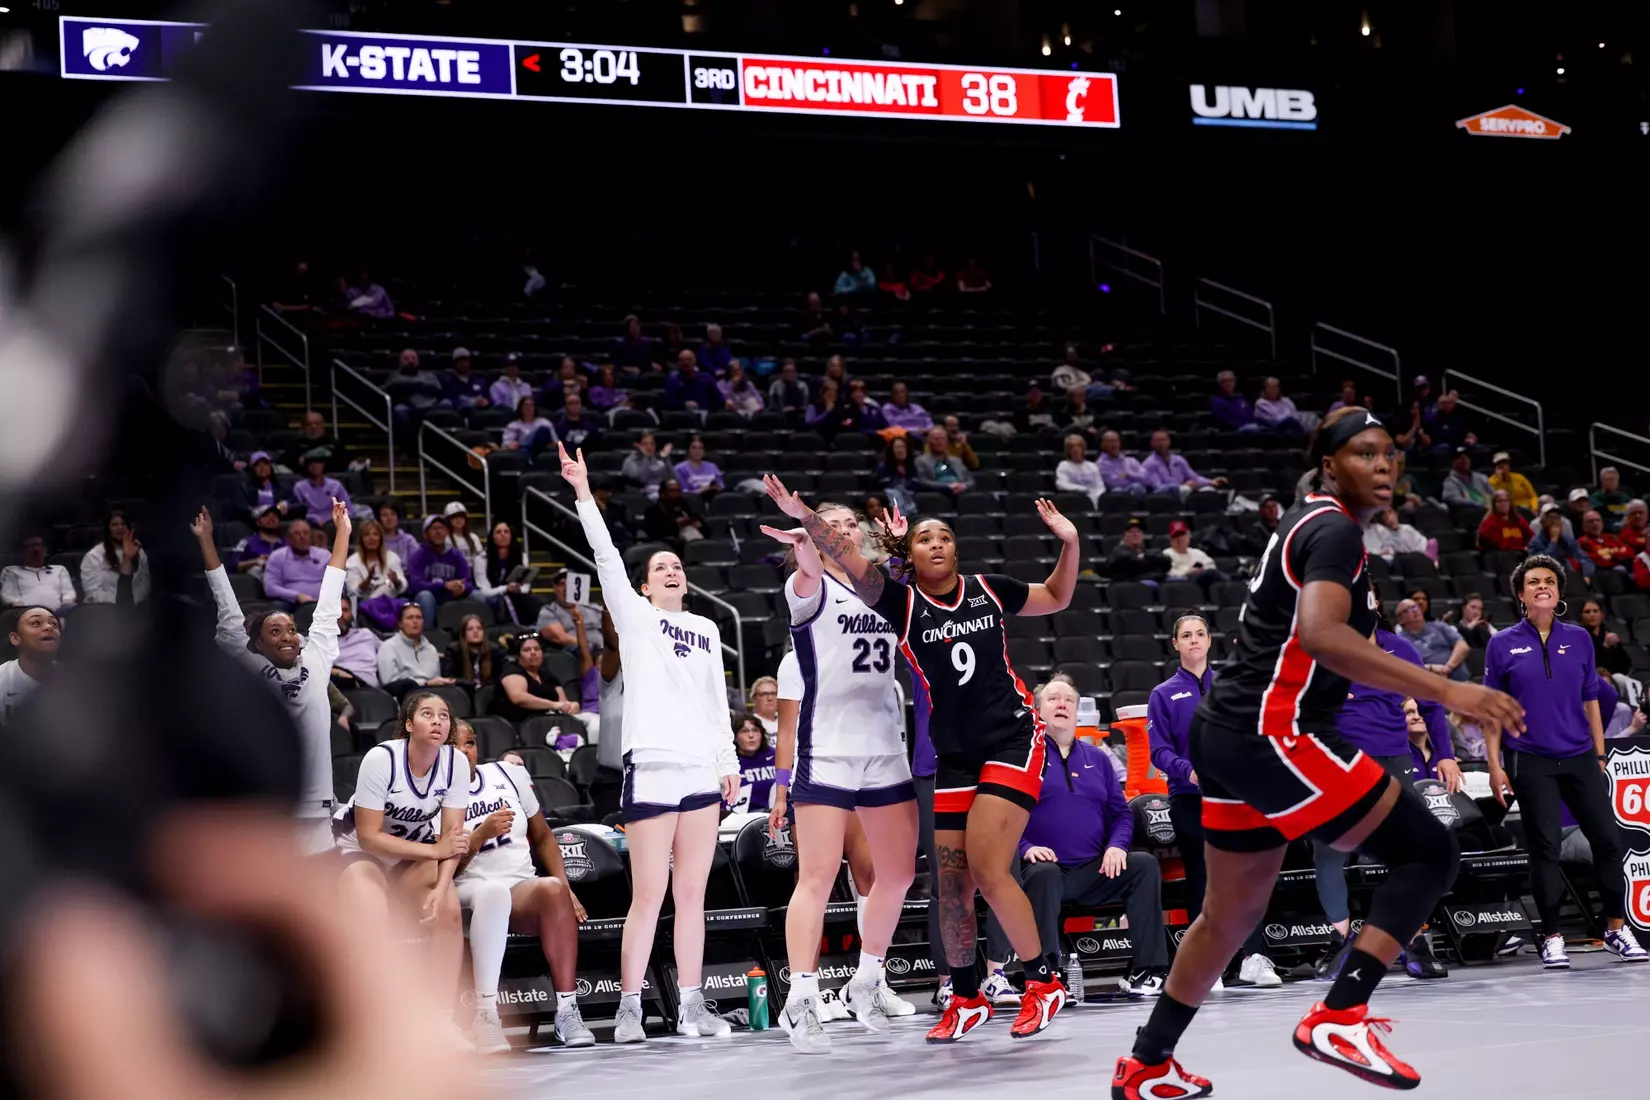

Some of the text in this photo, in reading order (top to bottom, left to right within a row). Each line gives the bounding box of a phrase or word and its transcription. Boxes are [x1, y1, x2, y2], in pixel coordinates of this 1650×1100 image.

[322, 43, 481, 84] K-STATE
[560, 48, 640, 85] 3:04
[694, 68, 735, 89] 3RD
[744, 66, 938, 107] CINCINNATI
[961, 73, 1017, 116] 38
[1190, 84, 1317, 121] UMB
[1480, 117, 1547, 134] SERVPRO
[574, 576, 582, 601] 3
[837, 613, 896, 634] Wildca
[922, 614, 995, 643] CINCINNATI
[852, 637, 891, 674] 23
[951, 641, 976, 687] 9
[1614, 760, 1650, 776] PHILLI
[1622, 783, 1650, 815] 6
[716, 913, 760, 921] CONFERENCE
[1478, 910, 1522, 923] Allstate
[1102, 937, 1132, 950] Allst
[913, 959, 936, 971] Alls
[594, 978, 650, 994] Allse
[704, 973, 748, 989] Allstat
[497, 989, 548, 1005] llstate
